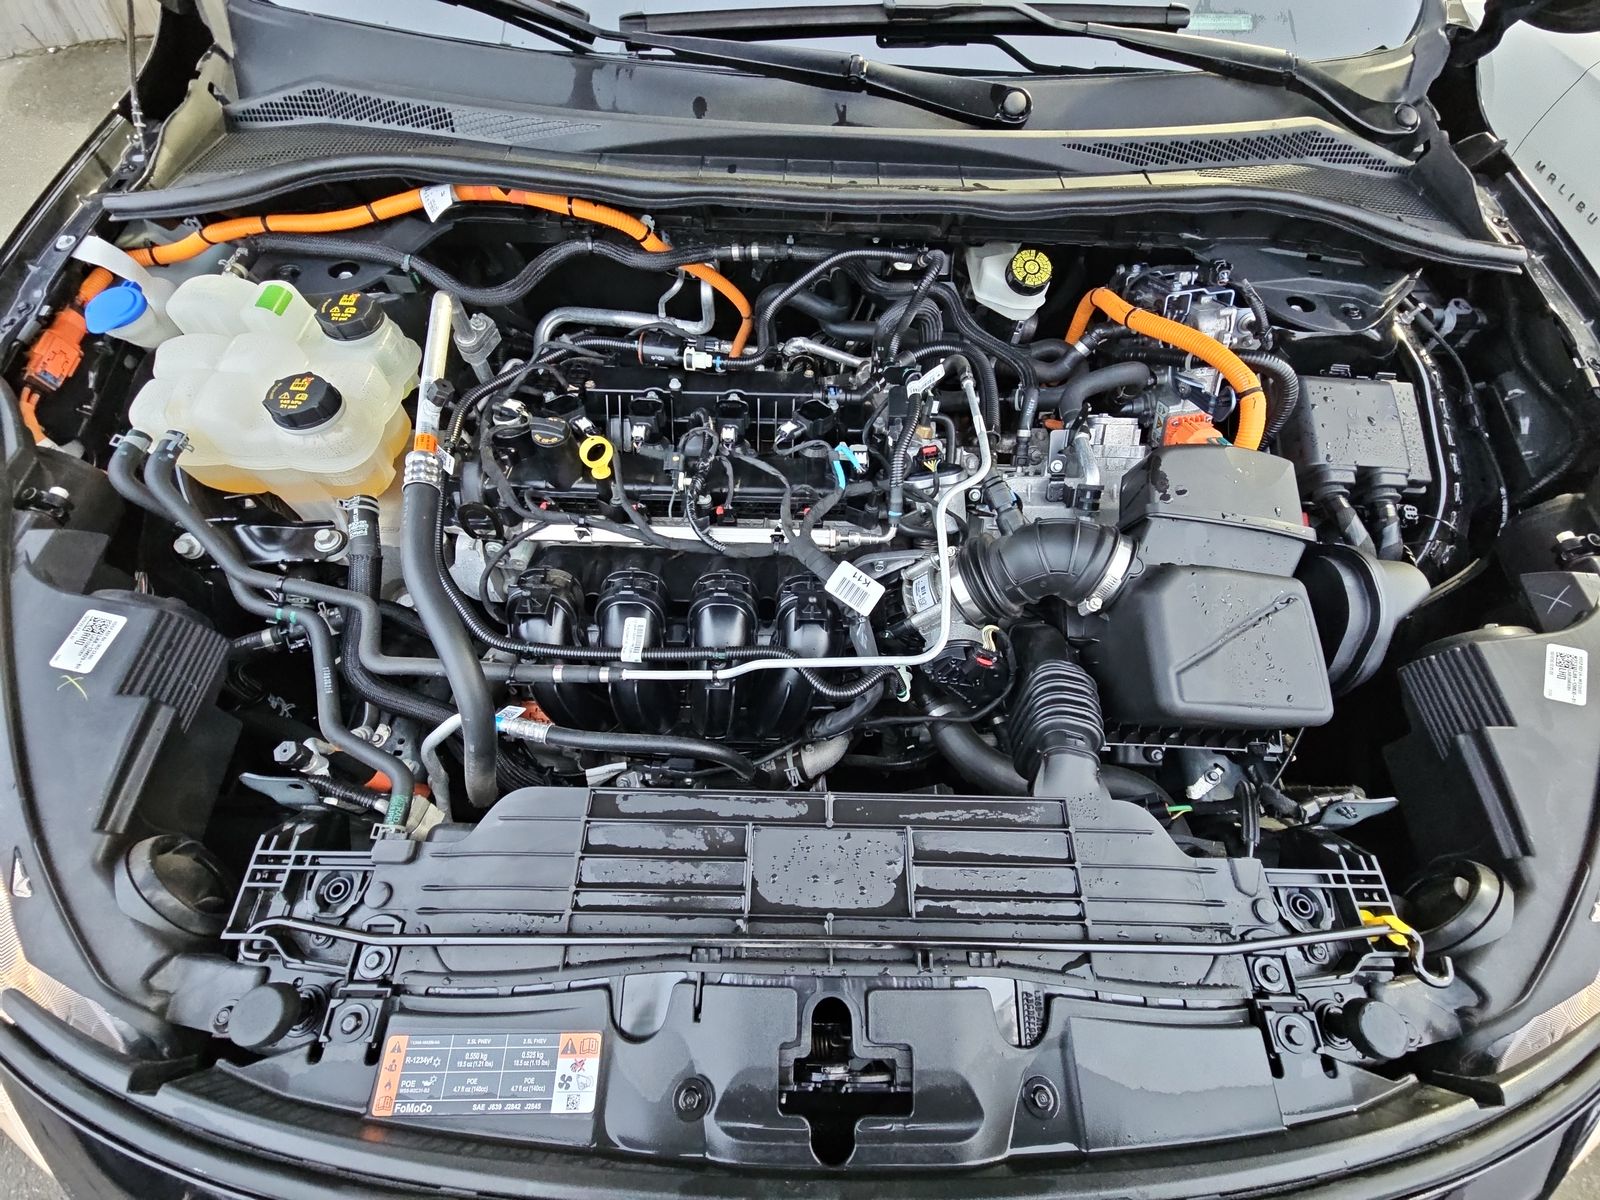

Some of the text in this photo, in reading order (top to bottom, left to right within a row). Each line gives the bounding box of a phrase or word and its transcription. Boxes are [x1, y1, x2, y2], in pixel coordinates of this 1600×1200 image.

[852, 572, 871, 587] K11
[405, 1056, 433, 1065] R-1234yf
[480, 1052, 488, 1061] kg
[394, 1104, 433, 1113] FoMoCo
